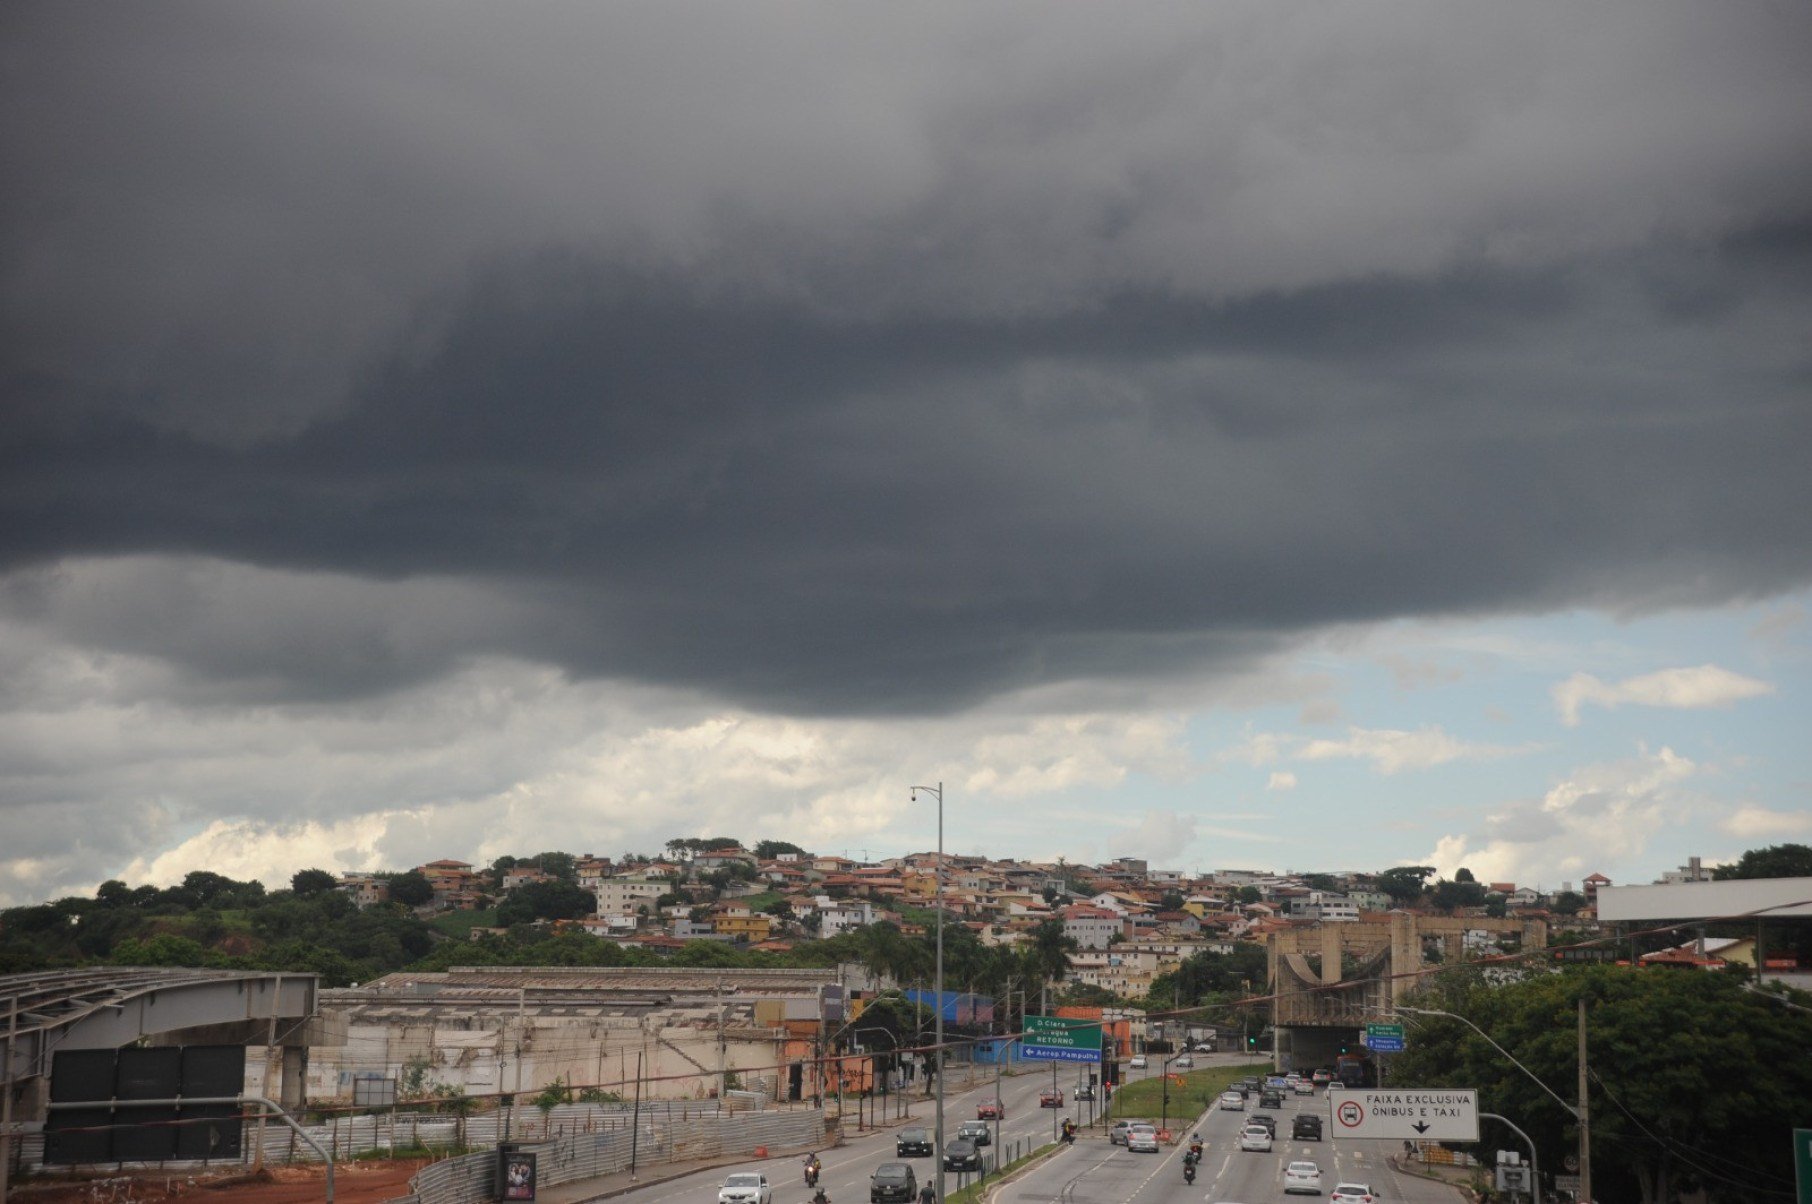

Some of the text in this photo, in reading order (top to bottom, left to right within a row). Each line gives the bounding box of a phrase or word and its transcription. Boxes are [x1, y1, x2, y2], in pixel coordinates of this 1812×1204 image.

[1044, 1020, 1066, 1028] Clara
[1036, 1036, 1074, 1045] RETORNO
[1061, 1050, 1098, 1059] Pampulha
[1366, 1095, 1471, 1104] FAIXA EXCLUSIVA
[1420, 1107, 1427, 1117] E
[1434, 1105, 1460, 1117] TÁXI
